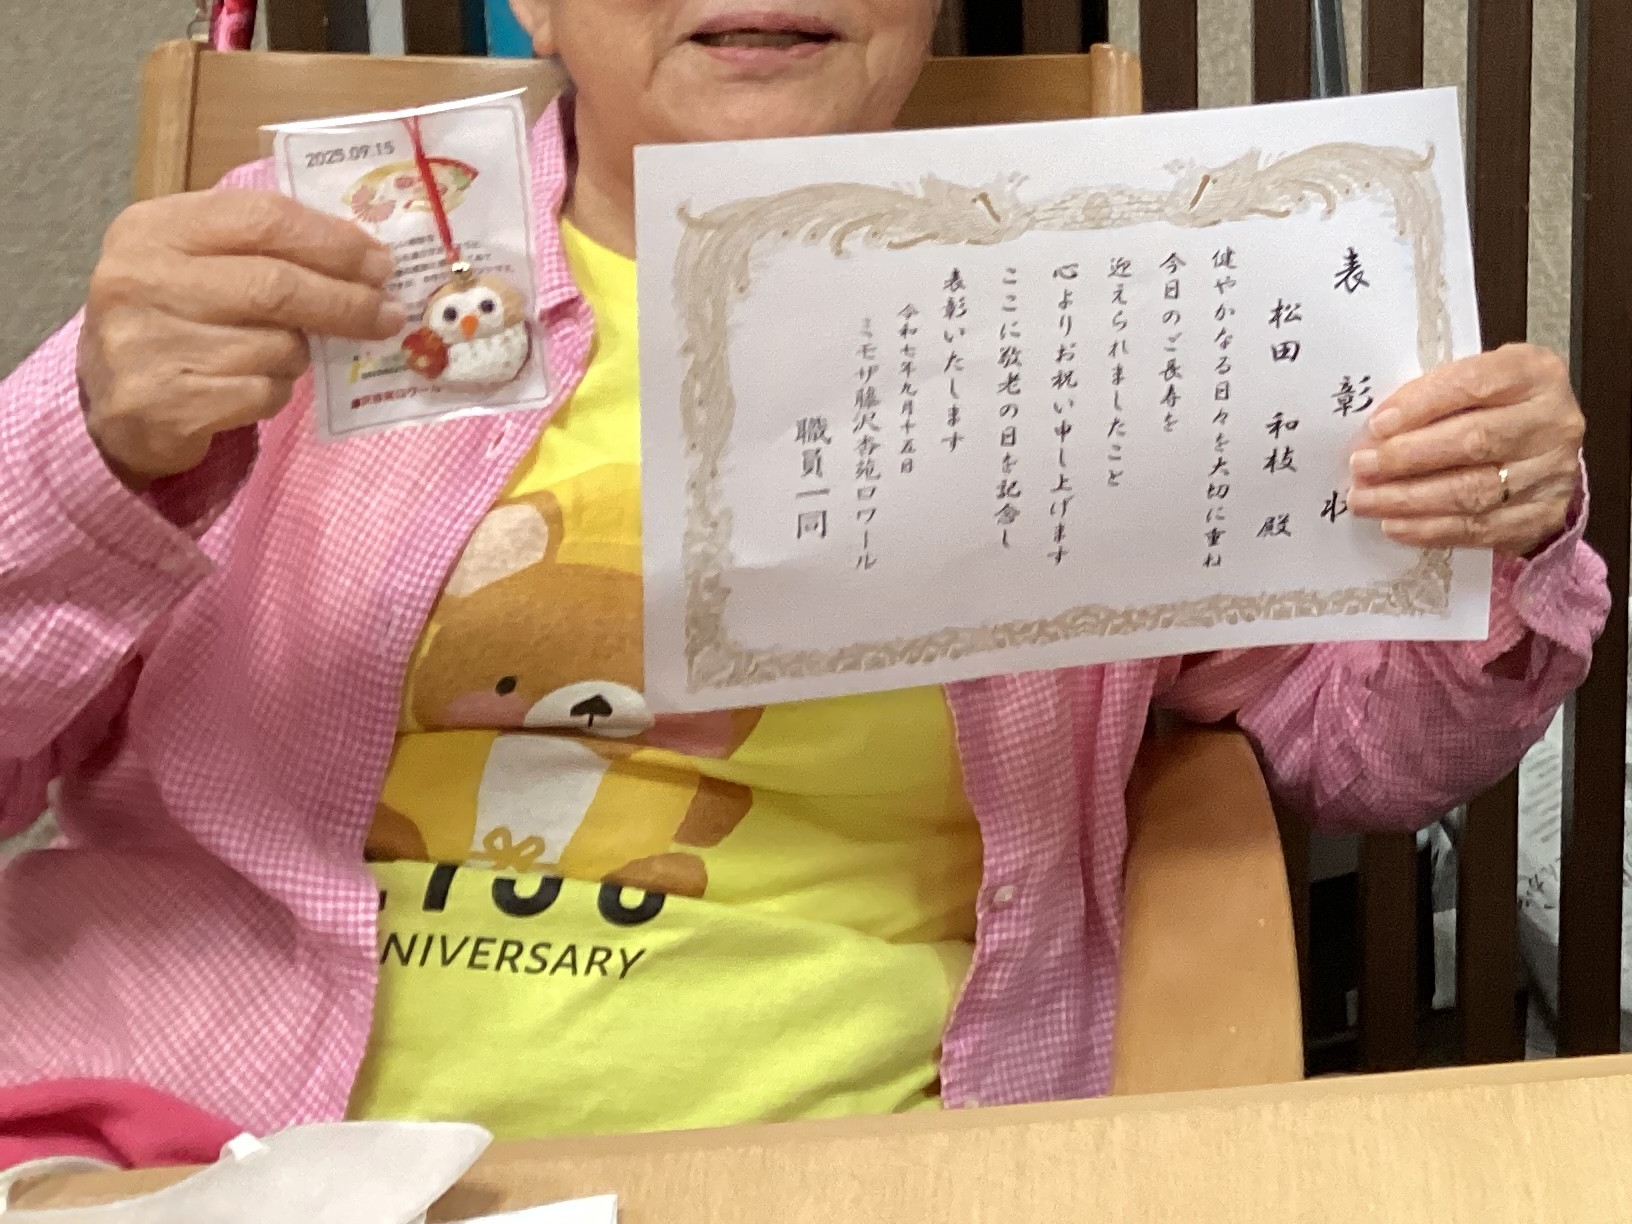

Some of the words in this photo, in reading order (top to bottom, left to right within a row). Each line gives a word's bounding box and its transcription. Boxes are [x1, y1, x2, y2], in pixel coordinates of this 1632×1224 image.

[1267, 297, 1303, 364] 松田
[1262, 411, 1300, 475] 和枝
[1255, 512, 1292, 538] 殿
[379, 932, 646, 980] NIVERSARY
